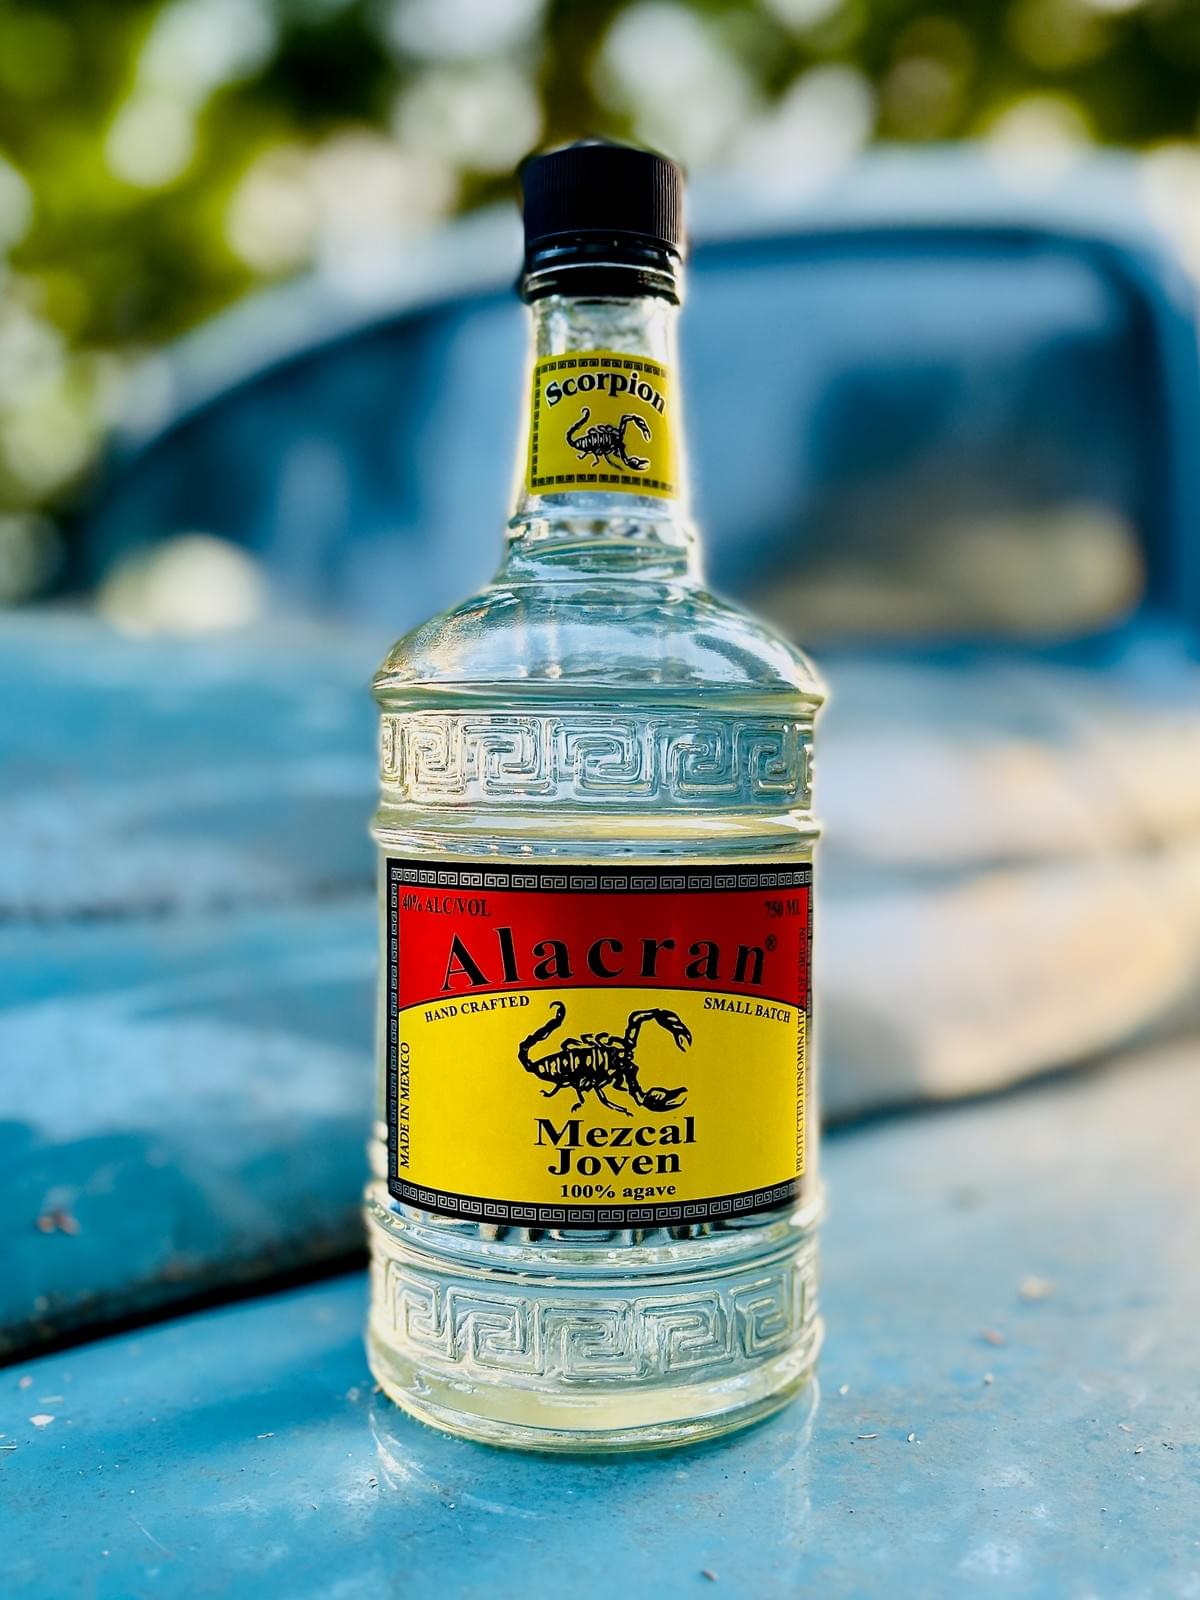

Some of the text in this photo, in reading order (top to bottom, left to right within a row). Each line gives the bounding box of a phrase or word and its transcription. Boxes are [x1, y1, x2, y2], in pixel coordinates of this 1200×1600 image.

[545, 371, 665, 416] Scorpion
[425, 895, 491, 918] ALC/VOL
[764, 899, 800, 917] 750 ML
[424, 995, 530, 1022] HAND CRAFTED
[703, 997, 791, 1023] SMALL BATCH
[400, 1042, 410, 1168] MADE IN MEXICO
[533, 1116, 697, 1147] Mezcal
[796, 1099, 805, 1172] PROTECTED
[547, 1148, 682, 1176] Joven
[560, 1184, 677, 1200] 100% agave
